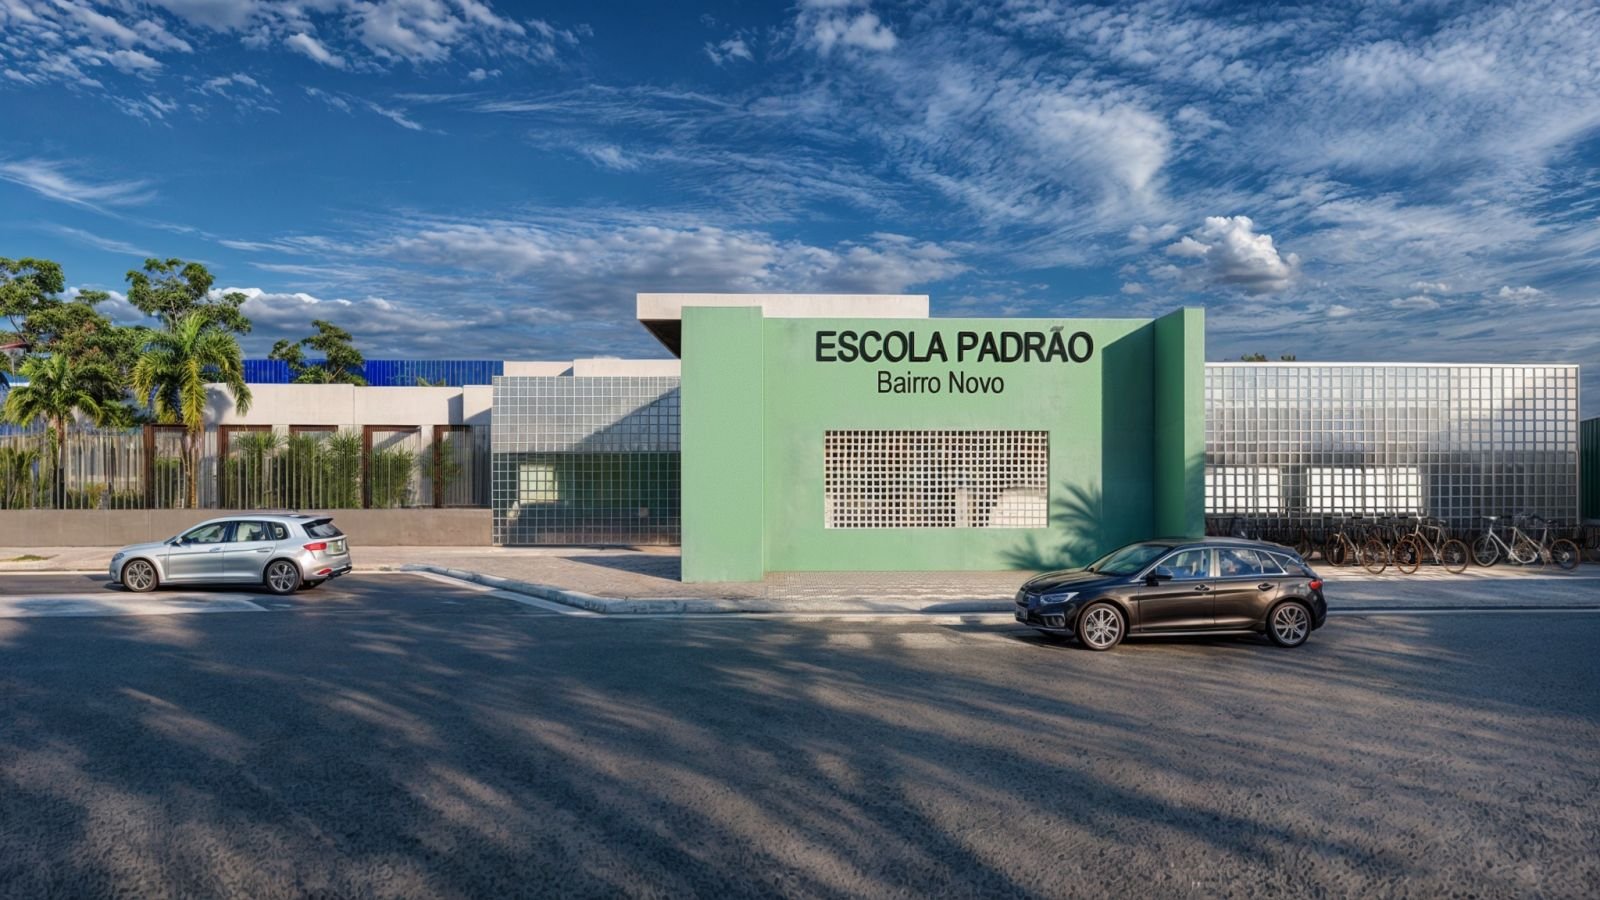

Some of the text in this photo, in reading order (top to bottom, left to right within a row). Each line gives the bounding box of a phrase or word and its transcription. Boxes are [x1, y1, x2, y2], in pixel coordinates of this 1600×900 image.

[815, 326, 1094, 363] ESCOLA PADRÃO
[877, 371, 1005, 394] Bairro Novo
